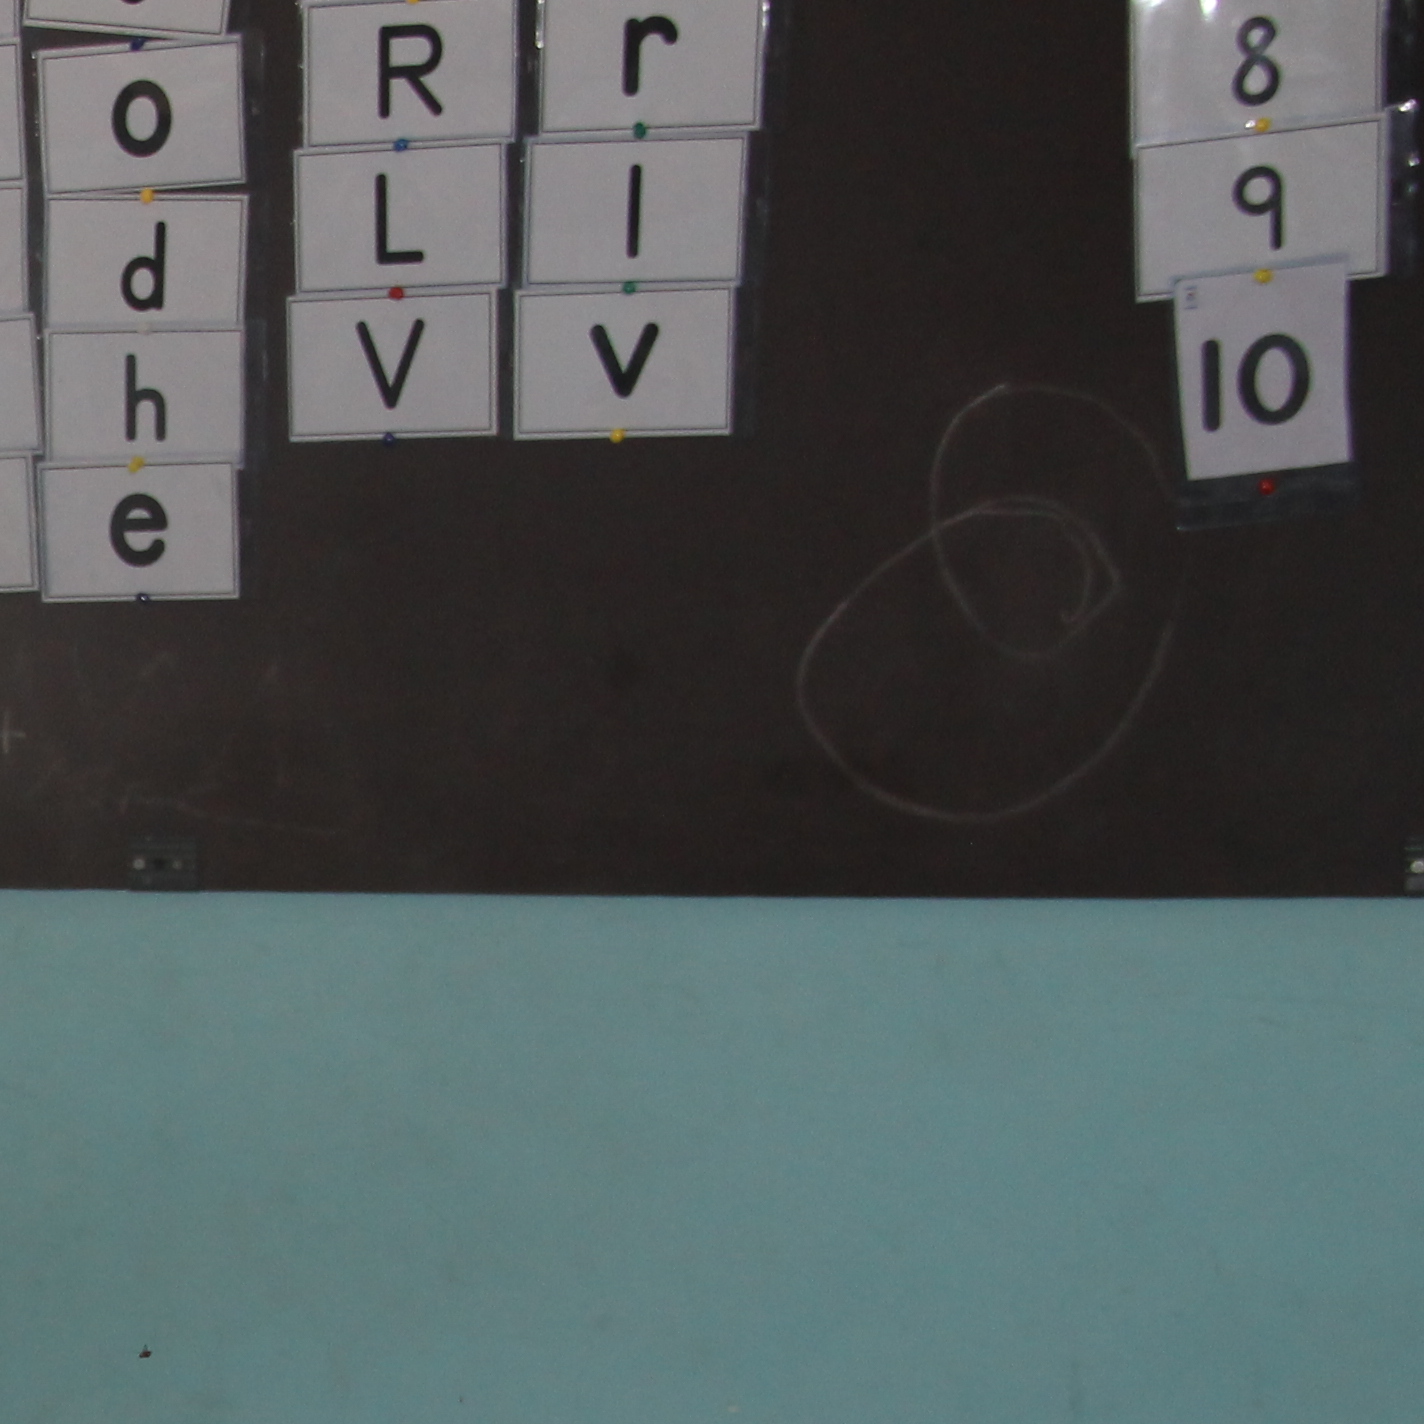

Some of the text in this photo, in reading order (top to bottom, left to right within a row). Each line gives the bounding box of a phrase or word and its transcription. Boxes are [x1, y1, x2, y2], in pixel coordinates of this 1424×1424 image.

[379, 23, 444, 118] R
[622, 15, 678, 96] r
[1232, 16, 1281, 106] 8
[111, 79, 172, 158] o
[377, 173, 424, 265] L
[1233, 166, 1283, 251] 9
[121, 221, 166, 311] d
[125, 354, 167, 441] h
[356, 318, 426, 410] V
[590, 322, 660, 398] v
[1202, 331, 1312, 432] 10
[110, 493, 168, 567] e
